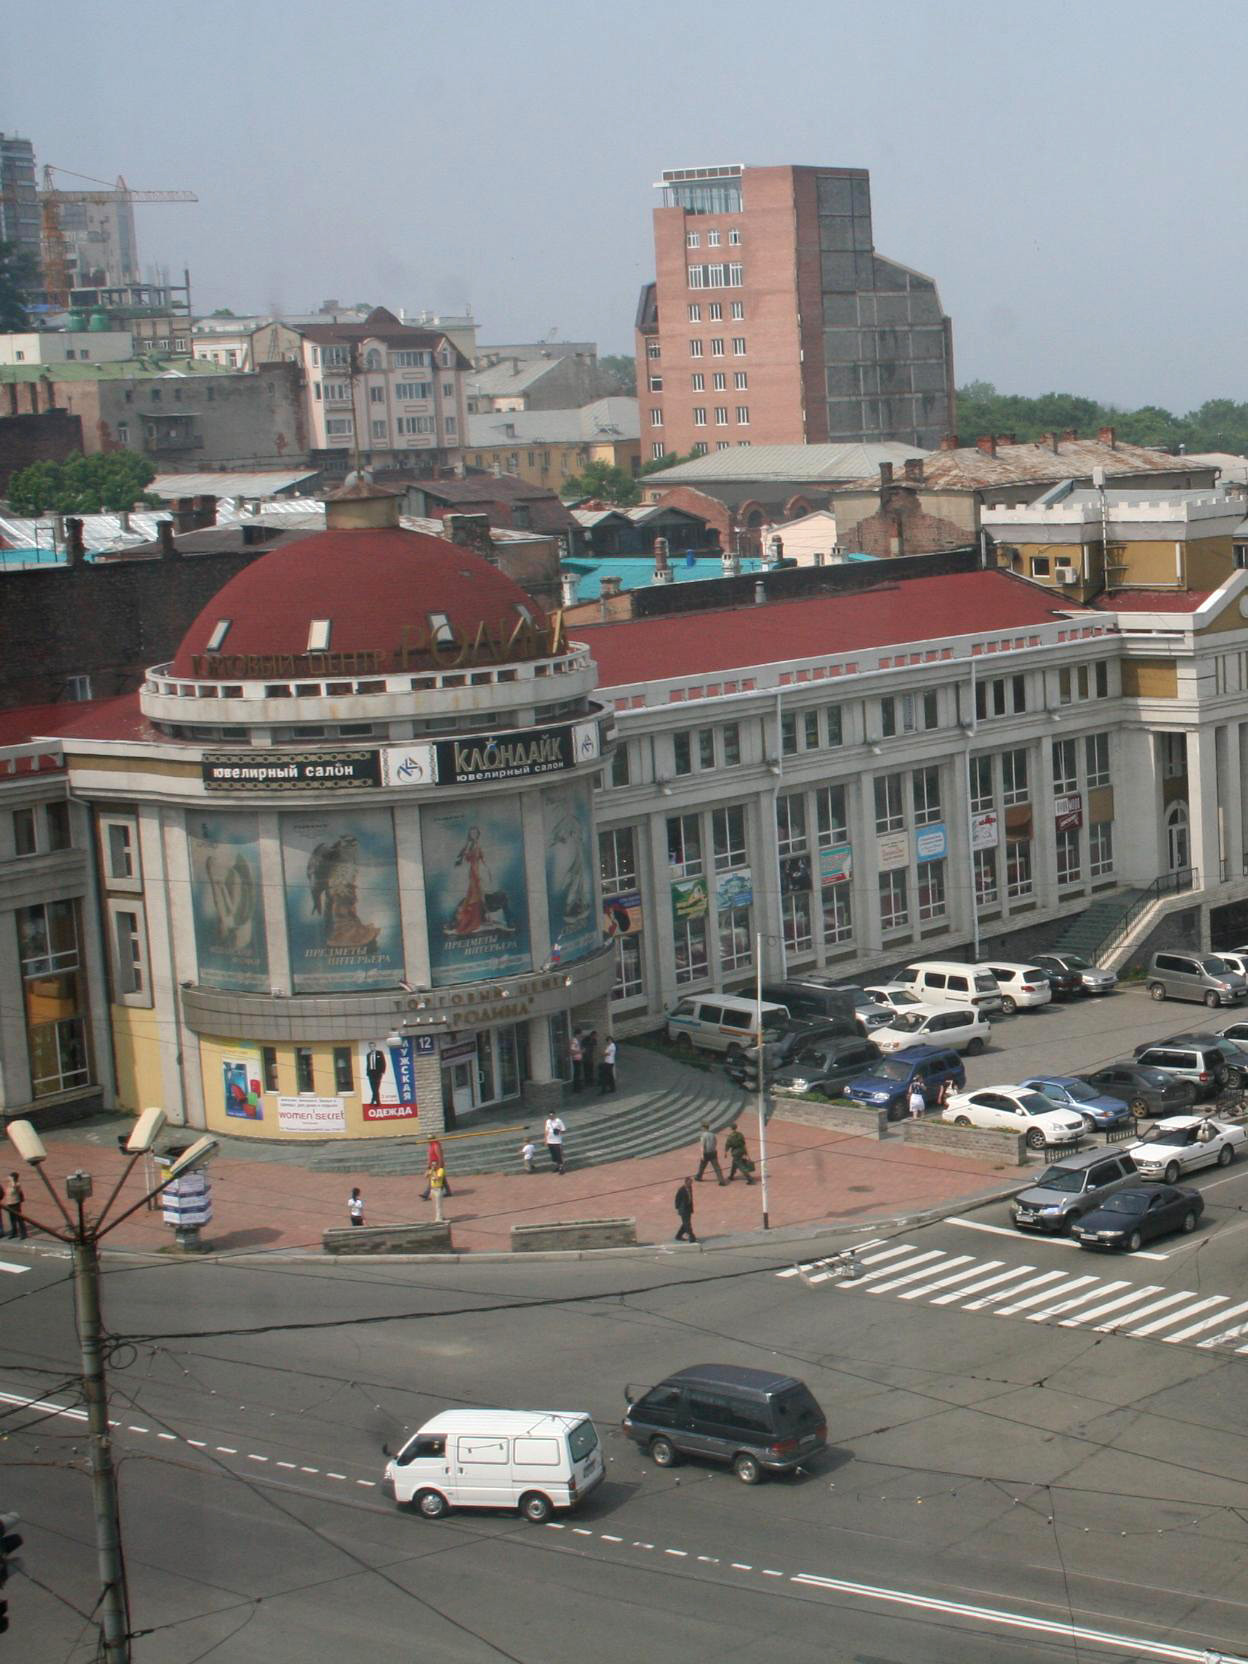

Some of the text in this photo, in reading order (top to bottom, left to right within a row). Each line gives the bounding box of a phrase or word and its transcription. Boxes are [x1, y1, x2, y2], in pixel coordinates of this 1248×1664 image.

[213, 763, 354, 781] ювелирный салон
[457, 761, 564, 782] ювелирный салон
[419, 1037, 432, 1049] 12
[368, 1106, 412, 1118] ОДЕЖДА
